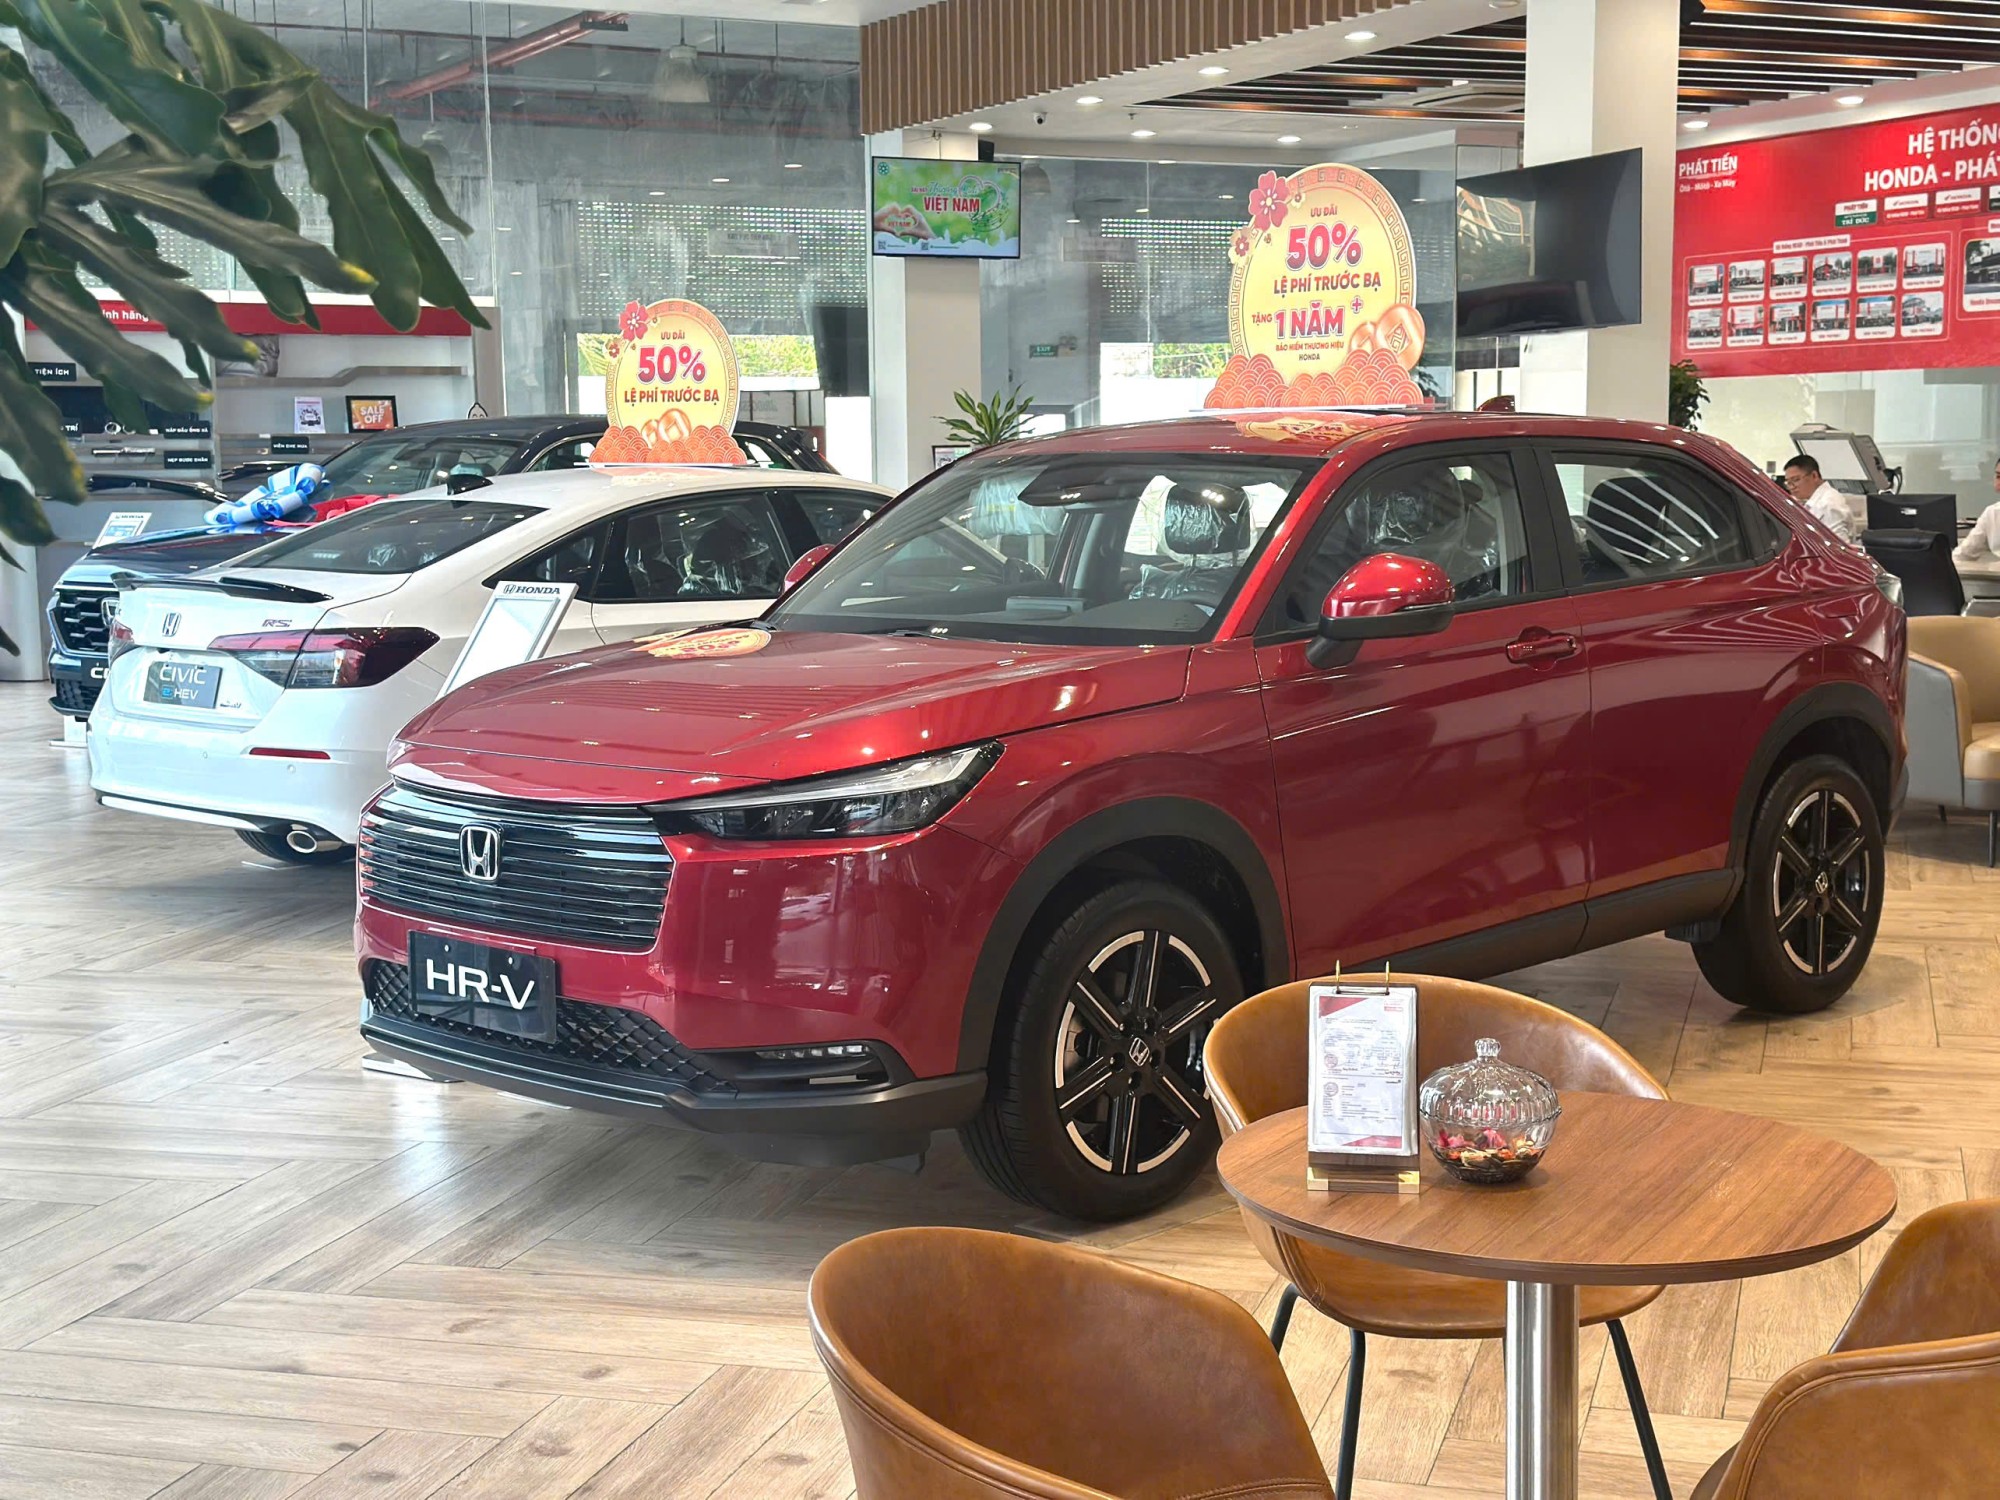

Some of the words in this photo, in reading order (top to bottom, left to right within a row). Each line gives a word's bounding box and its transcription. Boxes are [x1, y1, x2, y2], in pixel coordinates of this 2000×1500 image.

[1908, 127, 1935, 159] HỆ
[1938, 118, 2000, 150] THỐN
[1679, 157, 1709, 176] PHÁT
[1711, 152, 1738, 172] TIẾN
[1864, 164, 1938, 192] HONDA
[1954, 151, 2000, 181] PHÁ
[924, 194, 949, 214] VIỆT
[952, 197, 980, 213] NAM
[1286, 222, 1362, 270] 50%
[1273, 275, 1288, 298] LỆ
[1290, 273, 1312, 293] PHÍ
[1314, 270, 1360, 291] TRƯỚC
[1363, 272, 1381, 292] BẠ
[1251, 312, 1273, 326] TẶNG
[1275, 310, 1285, 338] 1
[1290, 301, 1344, 338] NĂM
[1304, 342, 1330, 350] THƯƠNG
[35, 367, 53, 376] TIỆN
[55, 367, 70, 376] ÍCH
[638, 345, 706, 384] 50%
[624, 387, 636, 407] LỆ
[639, 387, 658, 403] PHÍ
[660, 386, 701, 402] TRƯỚC
[704, 389, 720, 406] BẠ
[361, 405, 385, 416] SALE
[364, 414, 384, 424] OFF
[65, 422, 79, 432] TRÍ
[516, 585, 560, 595] HONDA
[262, 618, 292, 628] RS
[159, 664, 207, 685] CIVIC
[426, 958, 535, 1010] HR-V
